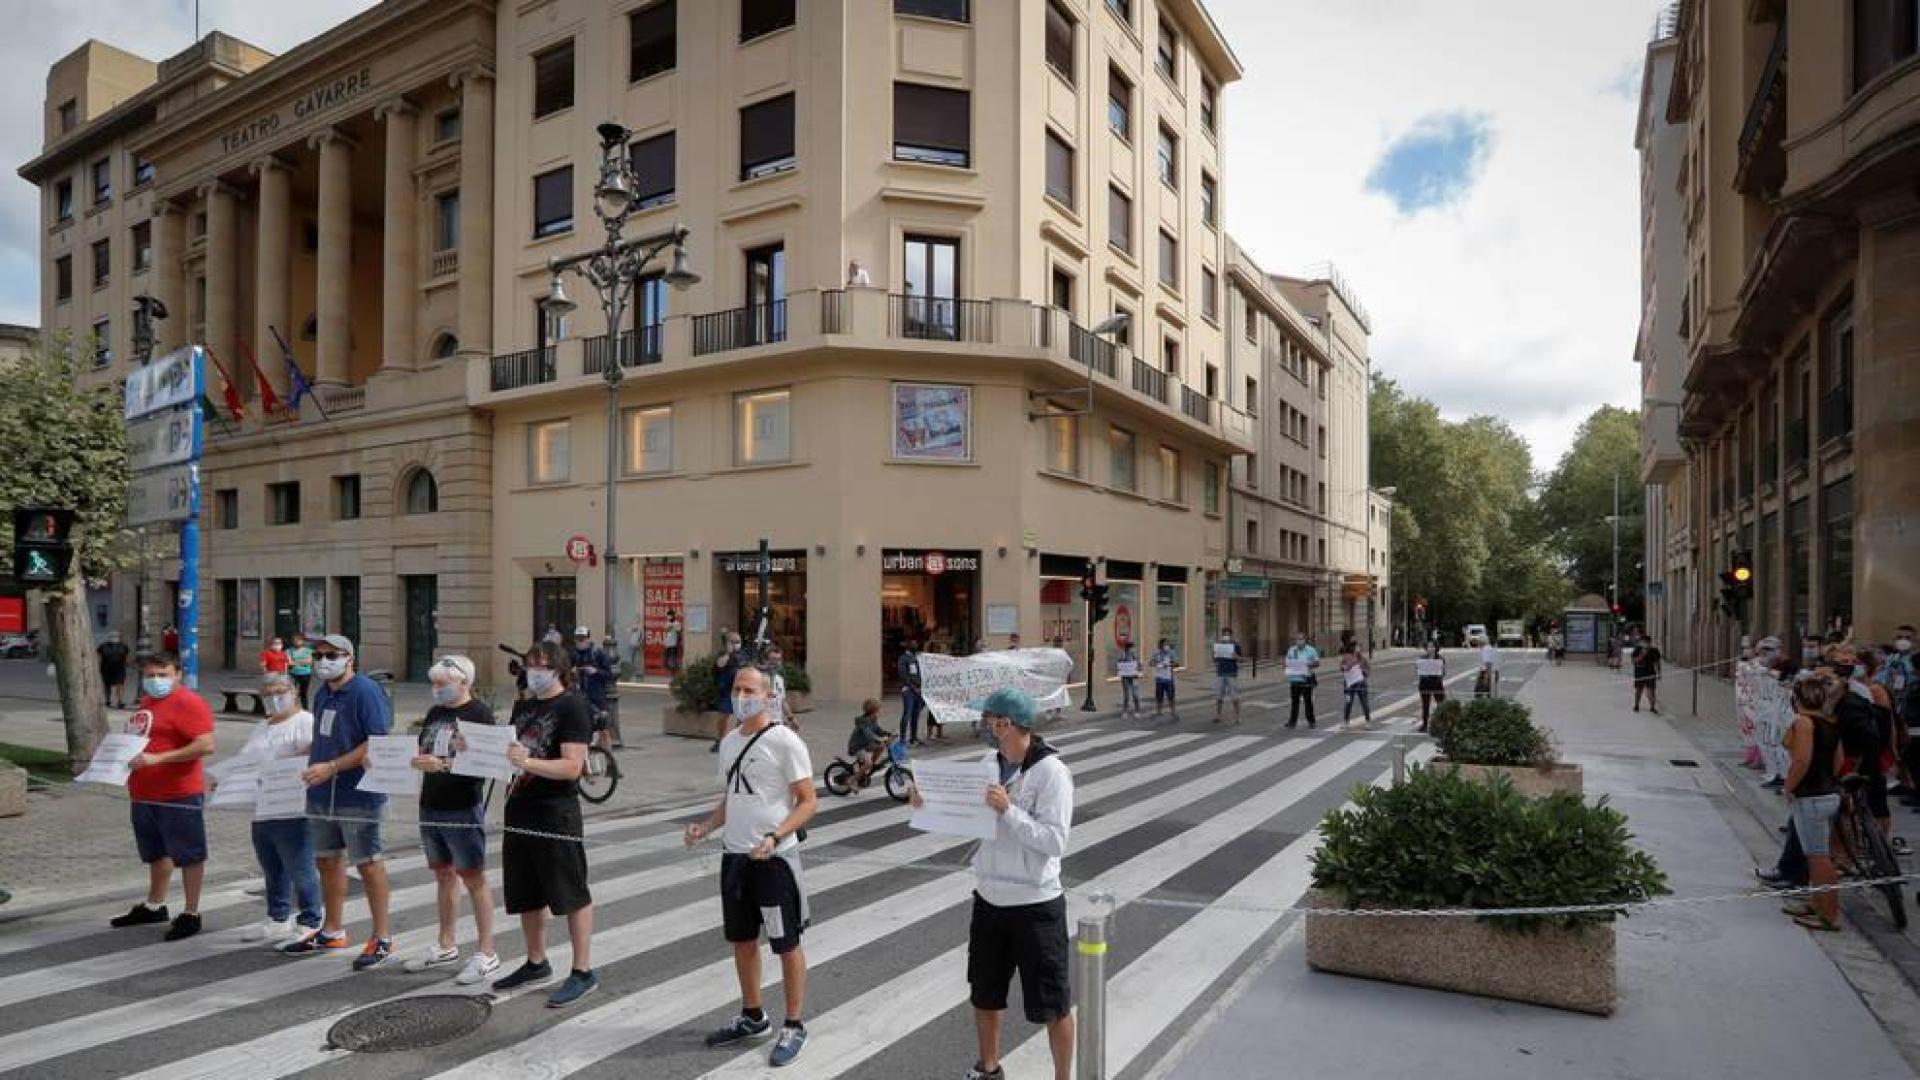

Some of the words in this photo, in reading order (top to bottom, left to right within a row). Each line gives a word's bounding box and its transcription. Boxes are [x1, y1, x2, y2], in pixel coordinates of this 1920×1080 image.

[221, 112, 280, 153] TEATRO
[294, 68, 371, 117] GAYARRE
[883, 551, 923, 569] urban
